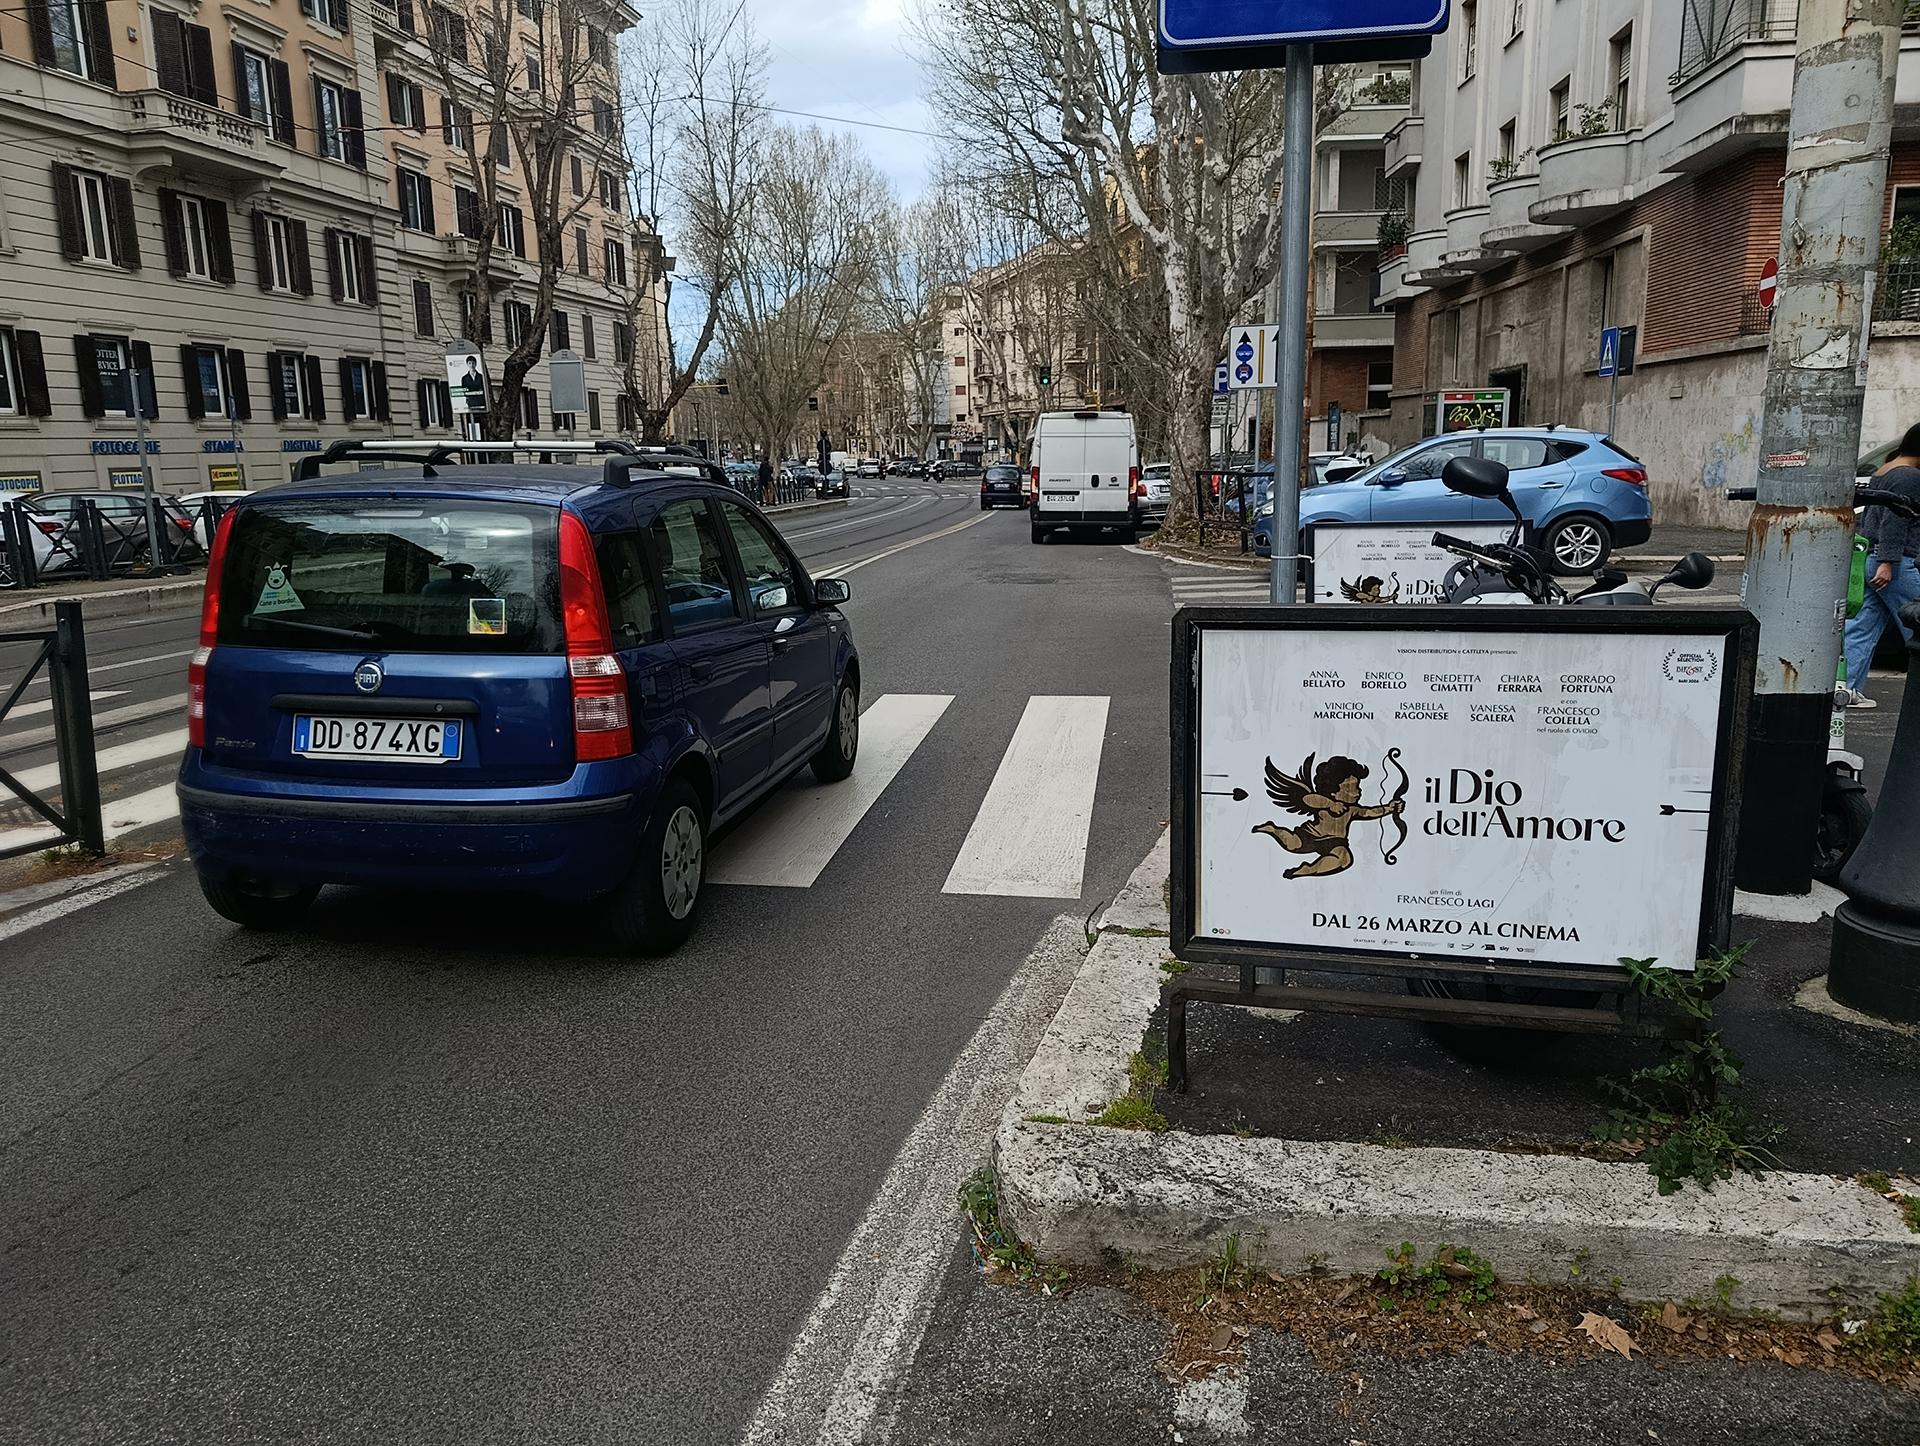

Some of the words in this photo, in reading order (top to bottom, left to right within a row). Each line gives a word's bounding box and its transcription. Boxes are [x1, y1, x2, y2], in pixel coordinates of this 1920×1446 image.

[1406, 583, 1413, 595] il
[1416, 579, 1445, 596] Dio
[359, 673, 377, 684] FIAT
[1309, 670, 1340, 679] ANNA
[1365, 671, 1404, 681] ENRICO
[1423, 673, 1482, 683] BENEDETTA
[1500, 674, 1541, 684] CHIARA
[1559, 674, 1616, 684] CORRADO
[1302, 679, 1346, 689] BELLATO
[1361, 680, 1408, 690] BORELLO
[1430, 683, 1474, 693] CIMATTI
[1497, 683, 1543, 694] FERRARA
[1560, 684, 1614, 694] FORTUNA
[1324, 702, 1364, 711] VINICIO
[1399, 702, 1445, 711] ISABELLA
[1470, 704, 1517, 714] VANESSA
[1537, 706, 1601, 716] FRANCESCO
[1313, 711, 1374, 720] MARCHIONI
[1394, 711, 1449, 721] RAGONESE
[1470, 713, 1515, 723] SCALERA
[1544, 716, 1591, 726] COLELLA
[312, 719, 343, 749] DD
[353, 720, 441, 753] 874XG
[1425, 777, 1441, 803] il
[1449, 768, 1523, 807] Dio
[1422, 805, 1627, 843] dell'Amore
[1397, 894, 1464, 907] FRANCESCO
[1467, 898, 1495, 909] LAGI
[1312, 912, 1351, 930] DAL
[1357, 915, 1380, 931] 26
[1386, 917, 1463, 935] MARZO
[1468, 920, 1494, 937] AL
[1497, 921, 1581, 943] CINEMA
[1500, 945, 1510, 953] sky
